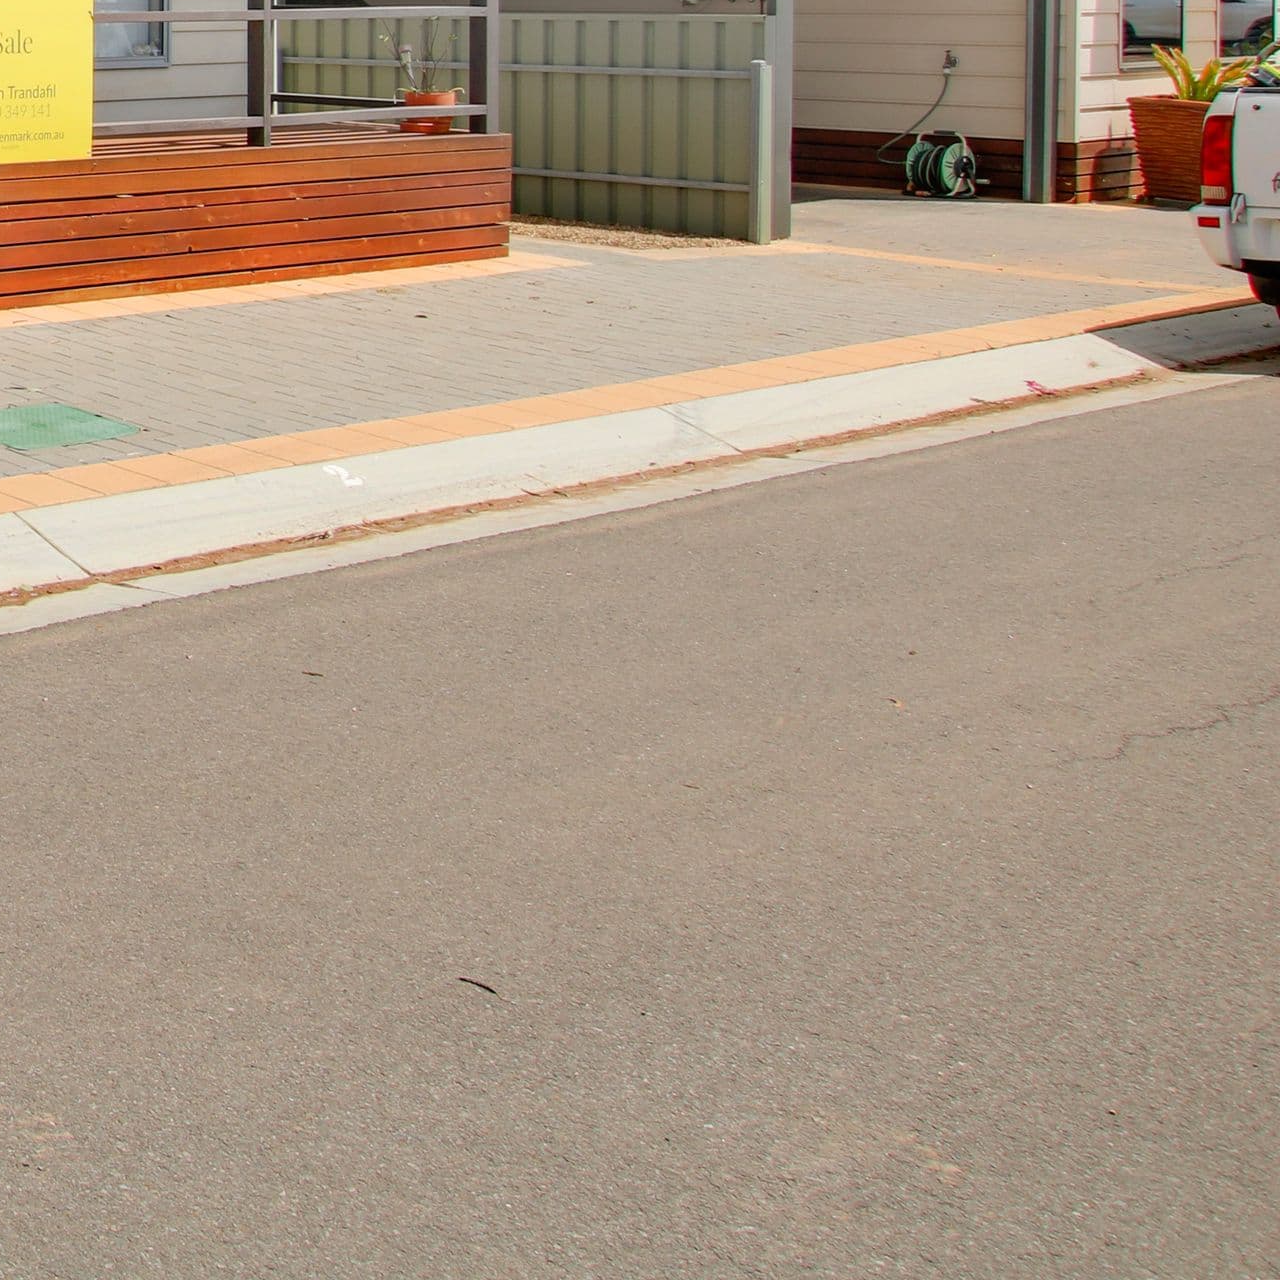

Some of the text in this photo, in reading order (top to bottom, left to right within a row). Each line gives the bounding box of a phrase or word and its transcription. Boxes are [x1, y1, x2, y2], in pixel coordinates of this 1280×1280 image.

[7, 84, 57, 100] Trandafil
[4, 103, 27, 119] 349
[31, 103, 51, 118] 141
